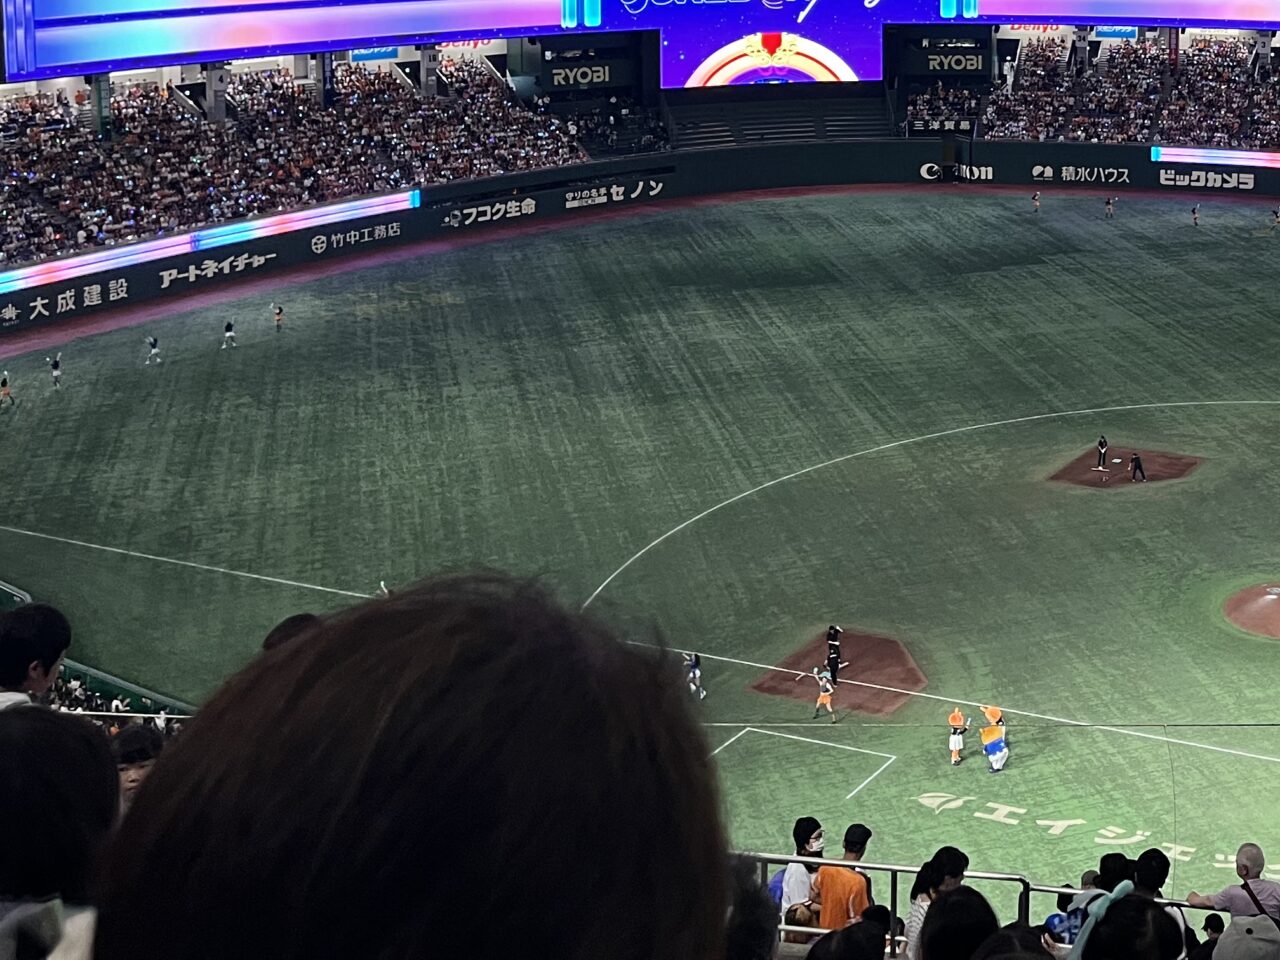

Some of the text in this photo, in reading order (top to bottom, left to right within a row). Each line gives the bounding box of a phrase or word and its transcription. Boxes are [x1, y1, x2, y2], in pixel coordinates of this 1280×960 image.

[927, 54, 983, 71] RYOBI
[552, 65, 610, 86] RYOBI
[913, 120, 971, 131] 三洋貿易
[919, 162, 993, 180] Cnon
[1061, 166, 1131, 184] 積水ハウス
[1159, 168, 1255, 190] ビックカメラ
[610, 180, 664, 202] セノン
[462, 197, 537, 226] フコク生命
[330, 221, 401, 249] 竹中工務店
[159, 252, 277, 289] アートネイチャー
[28, 278, 129, 321] 大成建設
